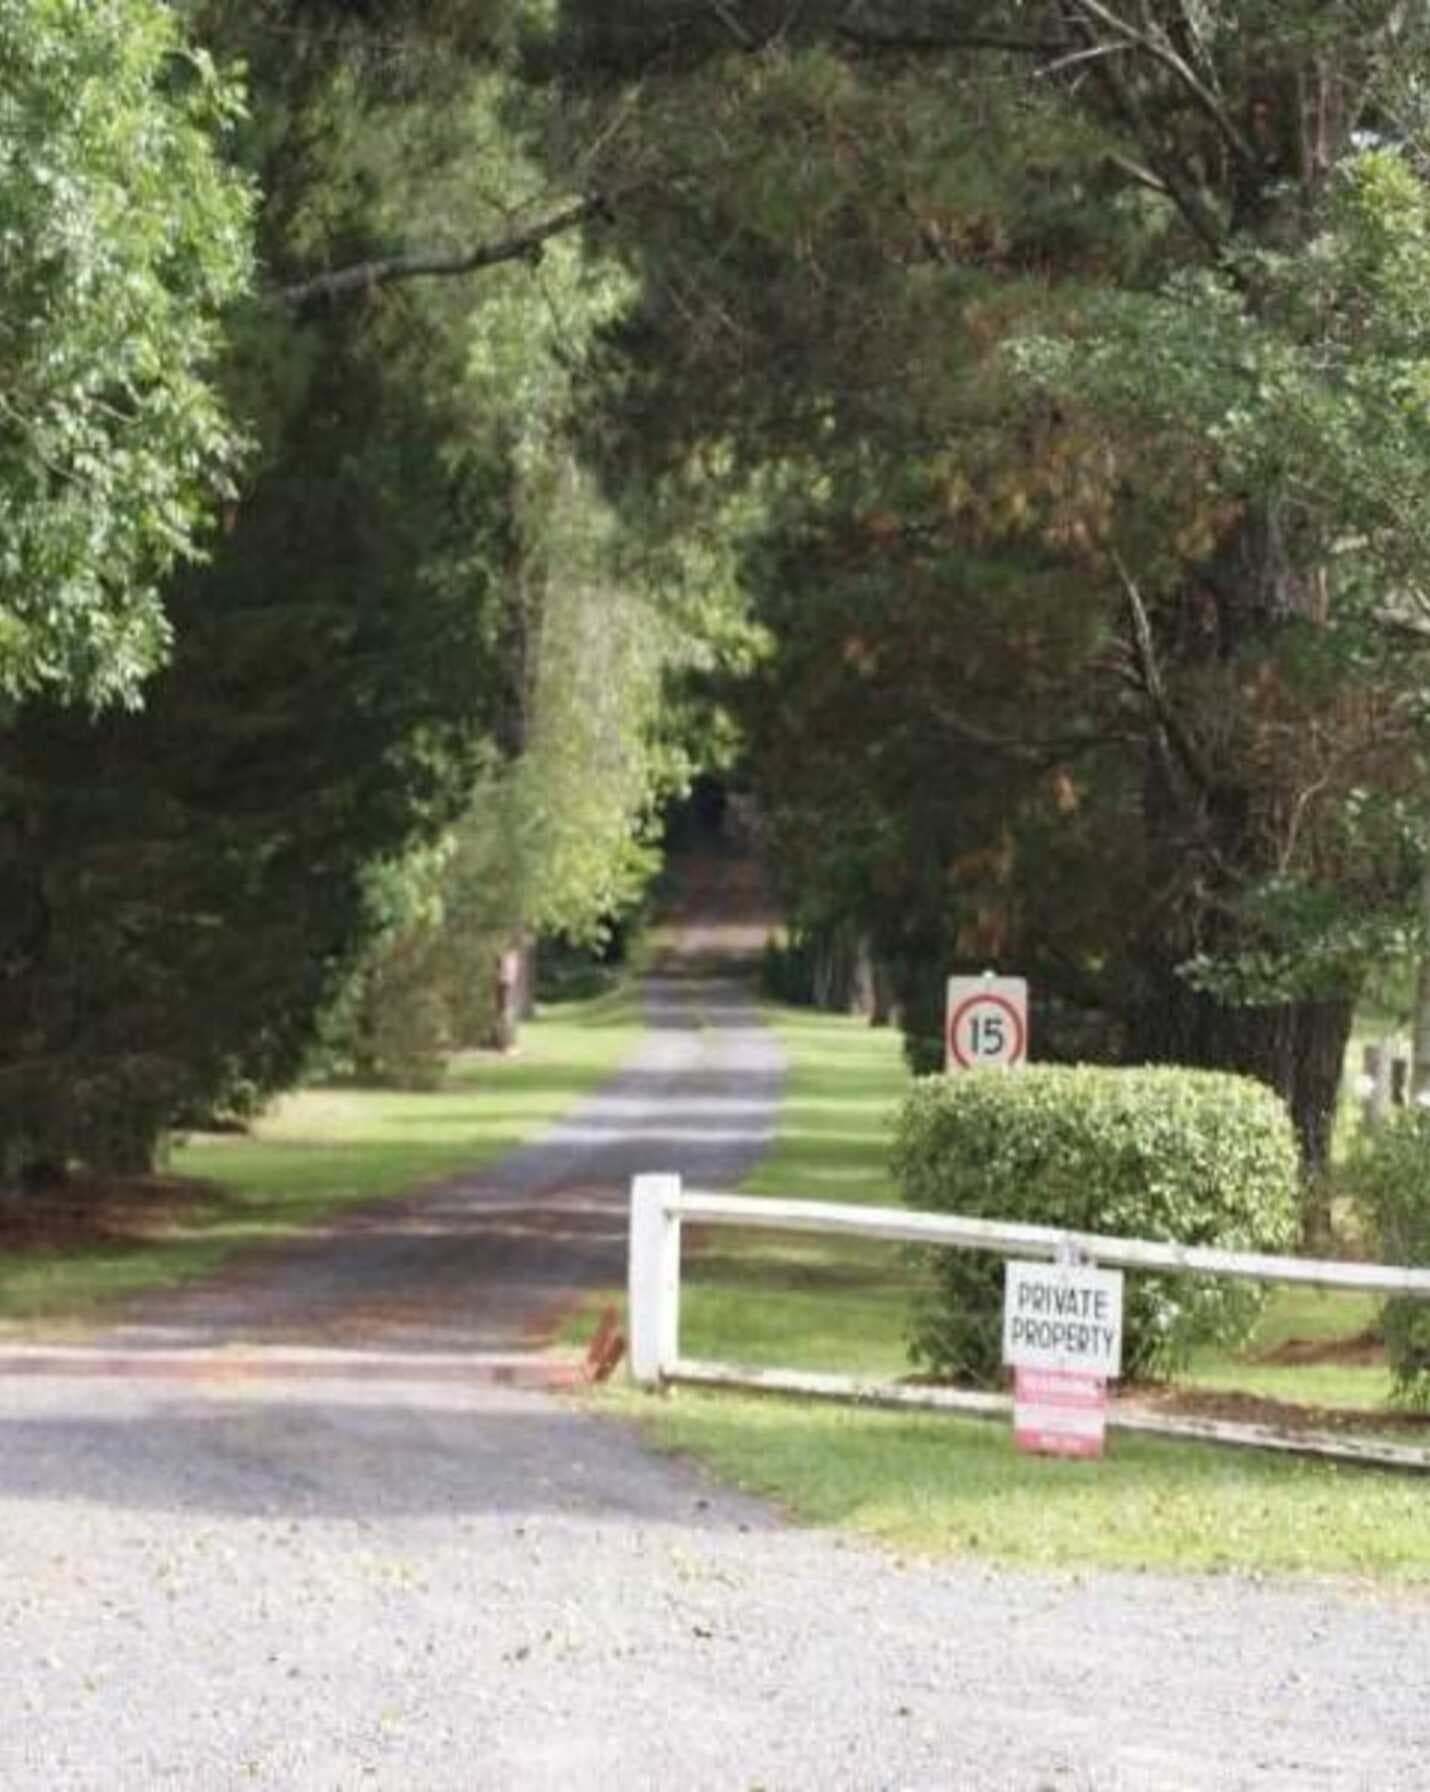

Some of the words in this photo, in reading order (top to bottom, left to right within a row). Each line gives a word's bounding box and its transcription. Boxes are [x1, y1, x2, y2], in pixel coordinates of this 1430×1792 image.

[969, 1018, 1004, 1055] 15
[1018, 1282, 1109, 1319] PRIVATE
[1011, 1316, 1114, 1357] PROPERTY
